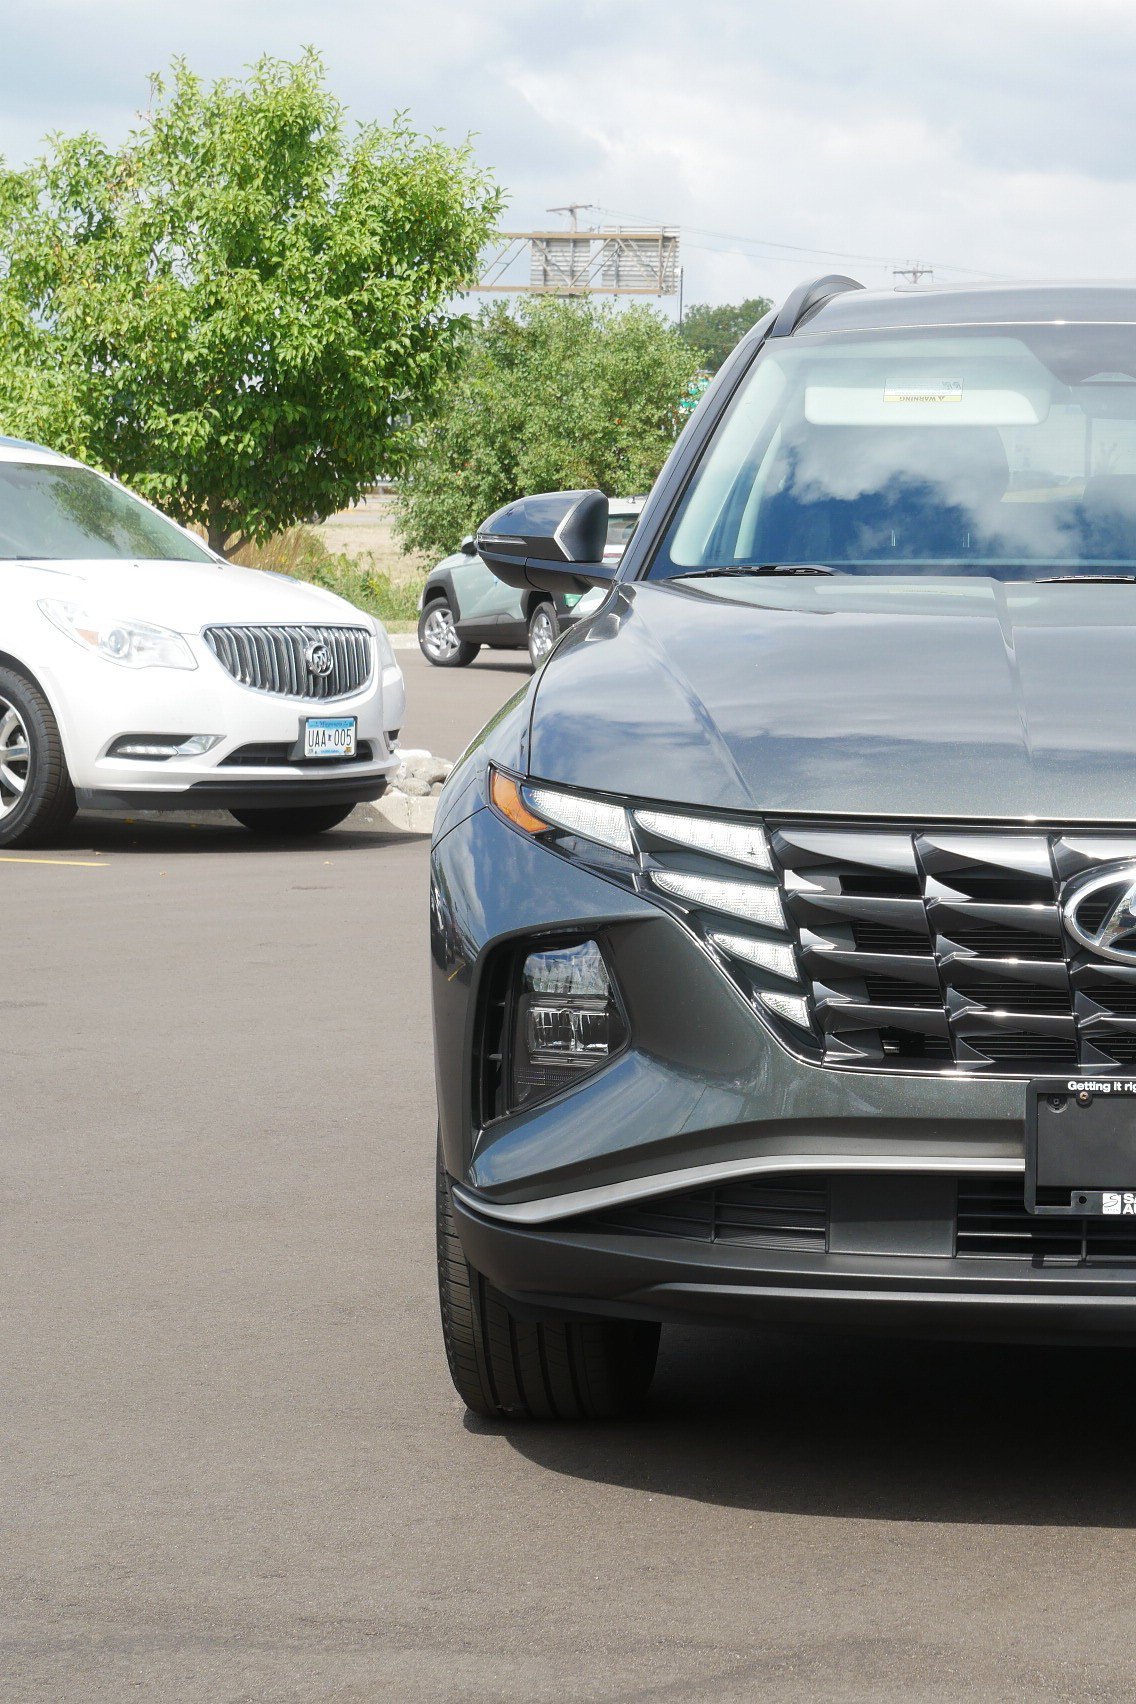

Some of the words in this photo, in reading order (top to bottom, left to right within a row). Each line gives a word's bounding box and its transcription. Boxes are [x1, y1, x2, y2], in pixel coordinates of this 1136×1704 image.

[308, 729, 327, 748] UAA
[334, 728, 352, 747] 005
[1067, 1080, 1111, 1093] Getting
[1113, 1080, 1123, 1092] it
